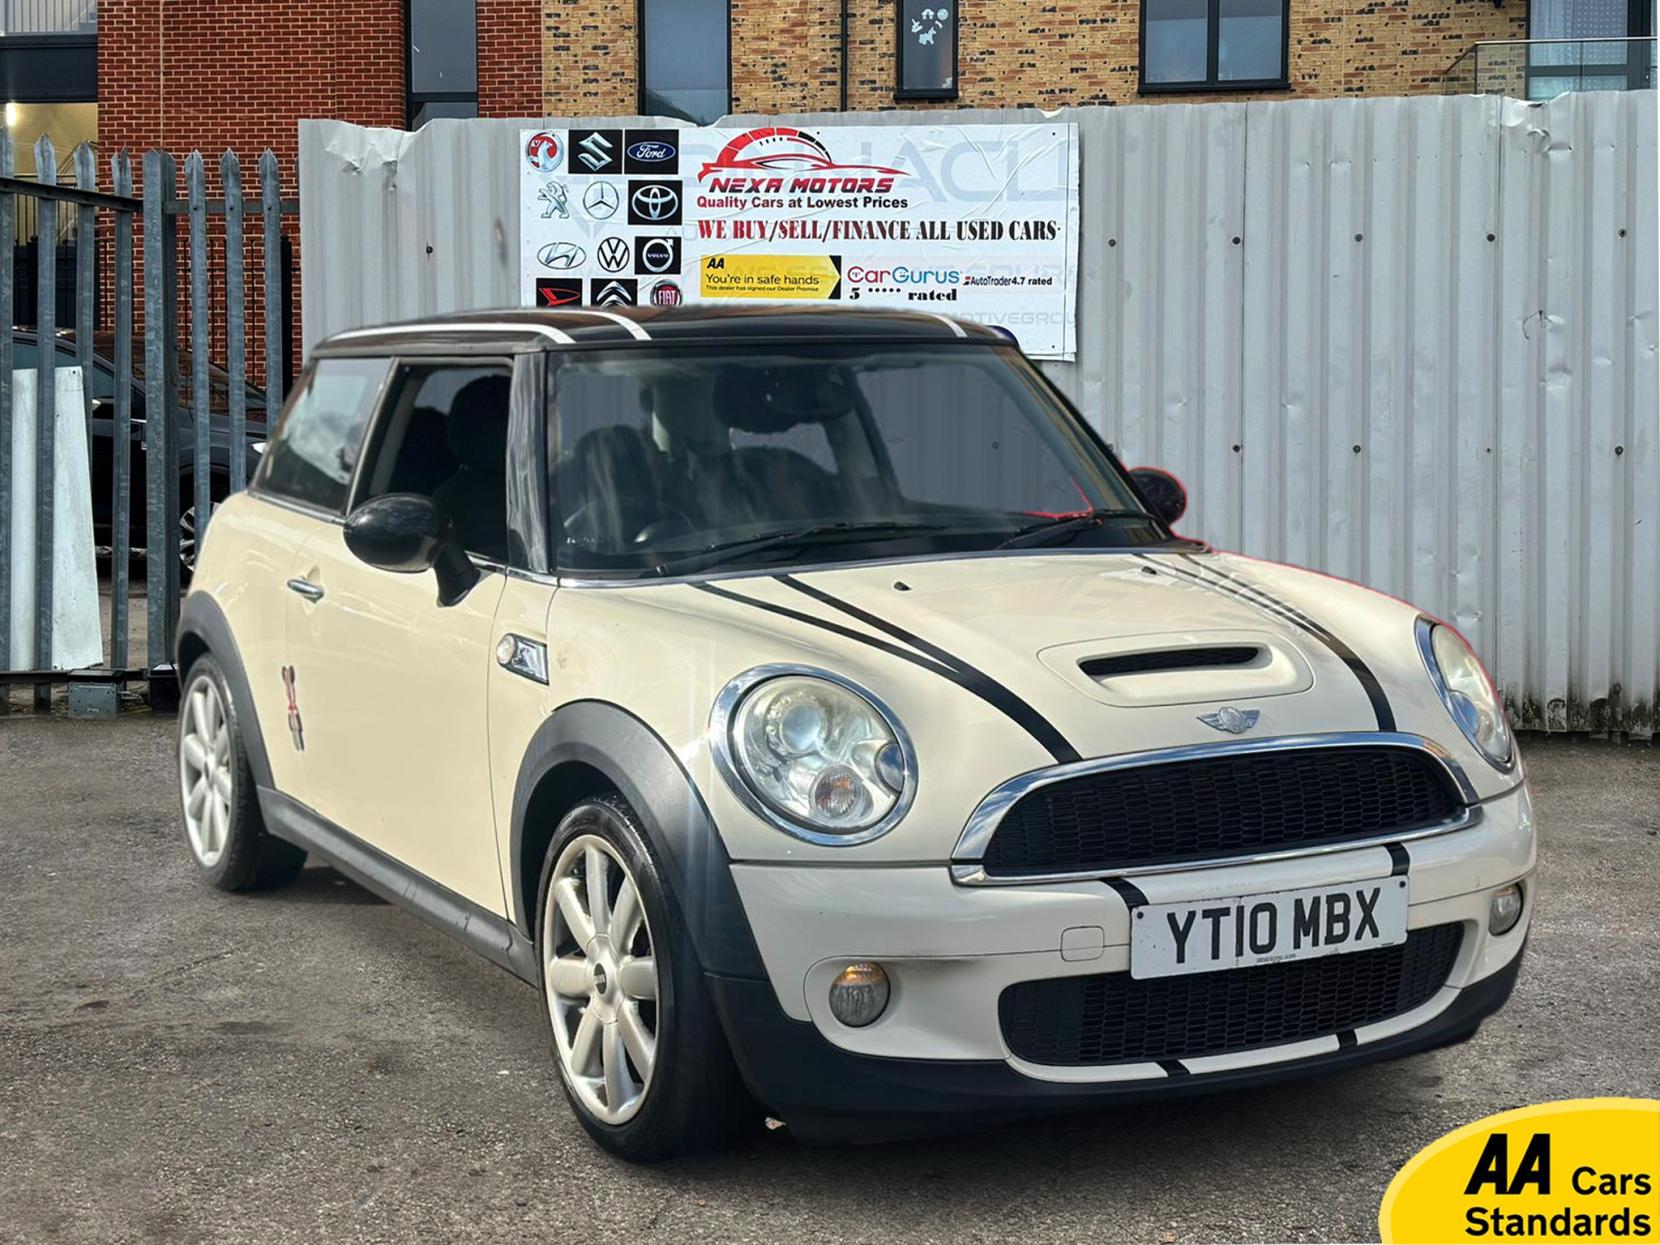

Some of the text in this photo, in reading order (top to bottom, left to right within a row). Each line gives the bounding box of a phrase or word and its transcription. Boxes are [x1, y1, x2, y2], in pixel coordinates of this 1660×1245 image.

[636, 144, 668, 160] Ford
[709, 178, 895, 193] NEXA MOTORS
[697, 196, 908, 211] Quality Cars at Lowest Prices
[697, 220, 727, 239] WE
[915, 220, 951, 240] ALL
[956, 220, 1003, 240] USED
[1008, 220, 1057, 240] CARS
[706, 258, 725, 269] AA
[706, 274, 819, 285] You're in safe hands
[847, 266, 960, 284] CarGurus
[1028, 277, 1053, 285] rated
[658, 290, 676, 305] FIAT
[849, 288, 957, 301] 5 rated
[1167, 887, 1381, 964] YT10 MBX
